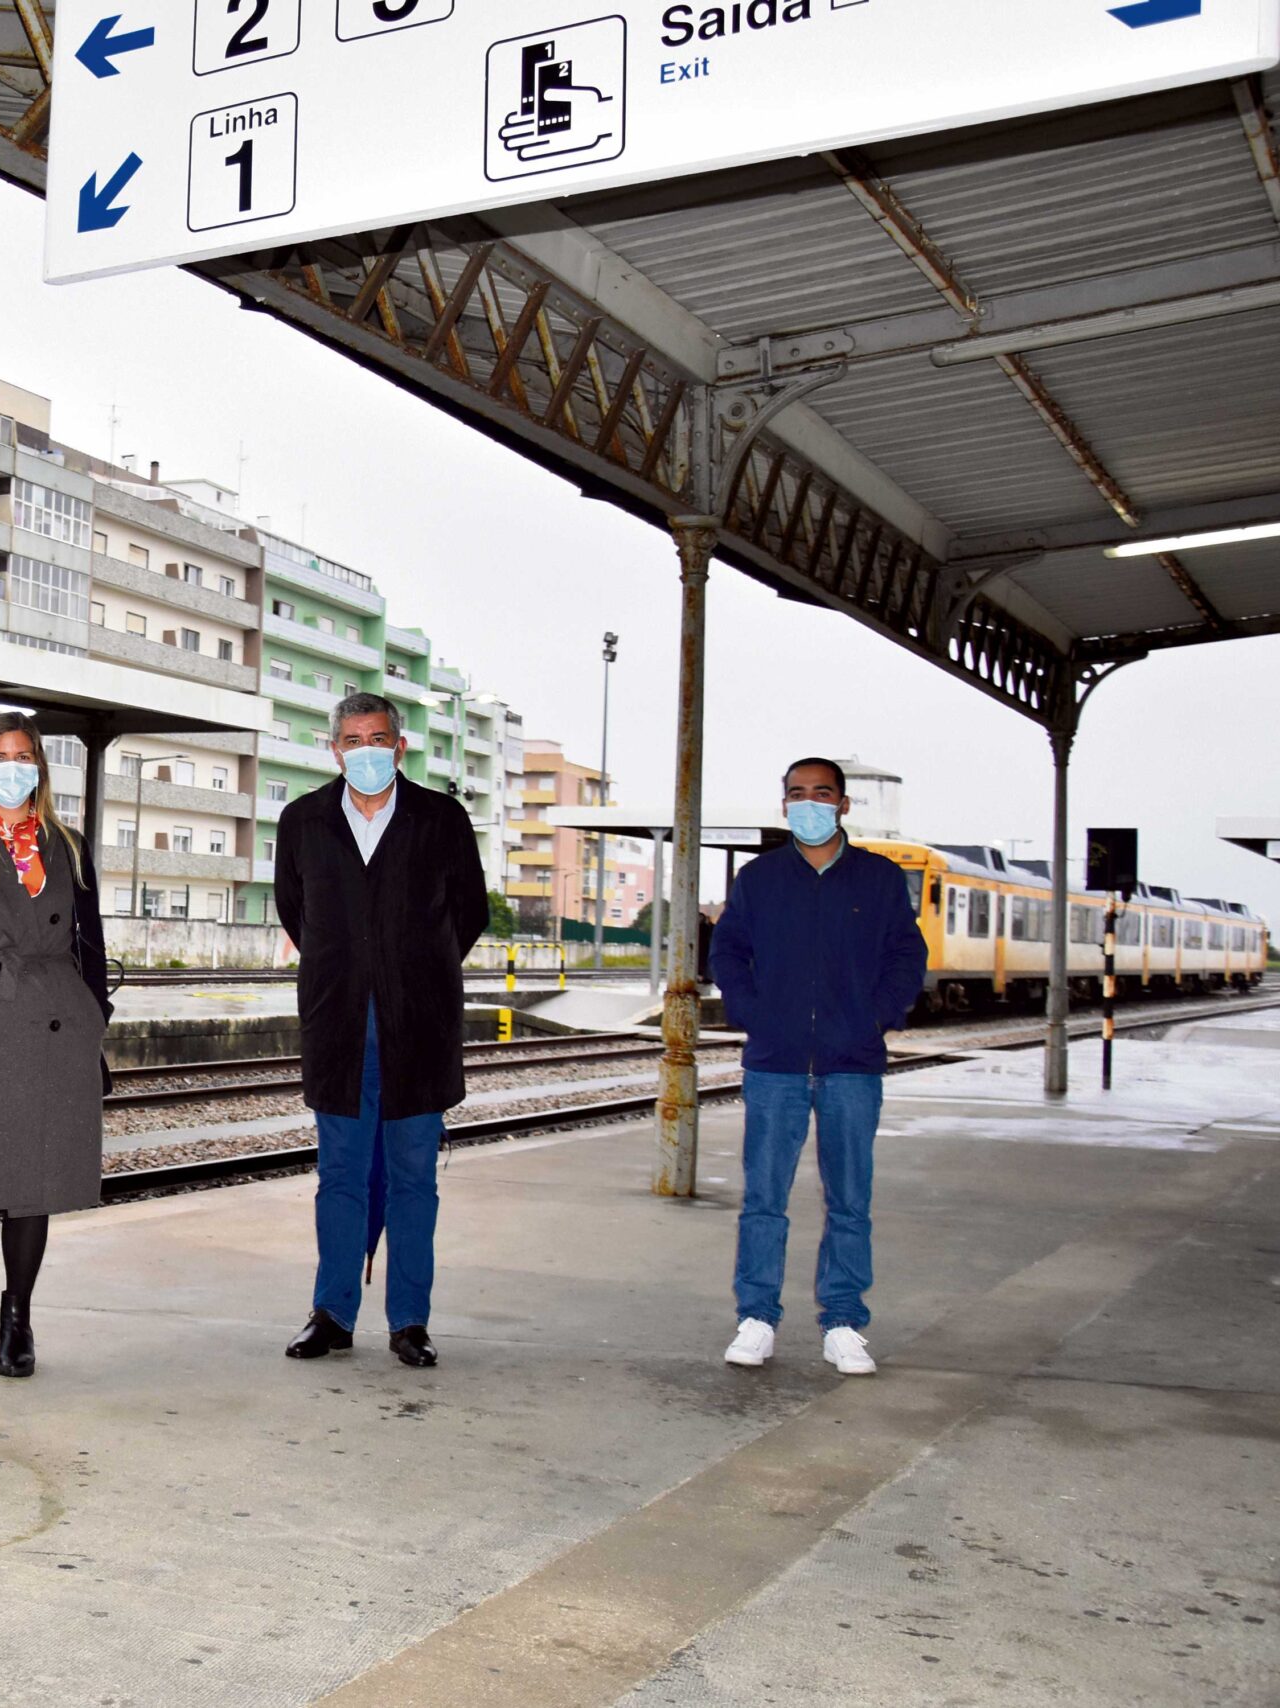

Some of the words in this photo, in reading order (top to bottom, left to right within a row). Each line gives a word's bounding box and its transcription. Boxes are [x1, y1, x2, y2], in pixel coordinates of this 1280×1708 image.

[225, 0, 269, 59] 2
[544, 43, 552, 58] 1
[558, 62, 569, 77] 2
[660, 57, 710, 84] Exit
[210, 107, 278, 138] Linha
[225, 139, 253, 212] 1
